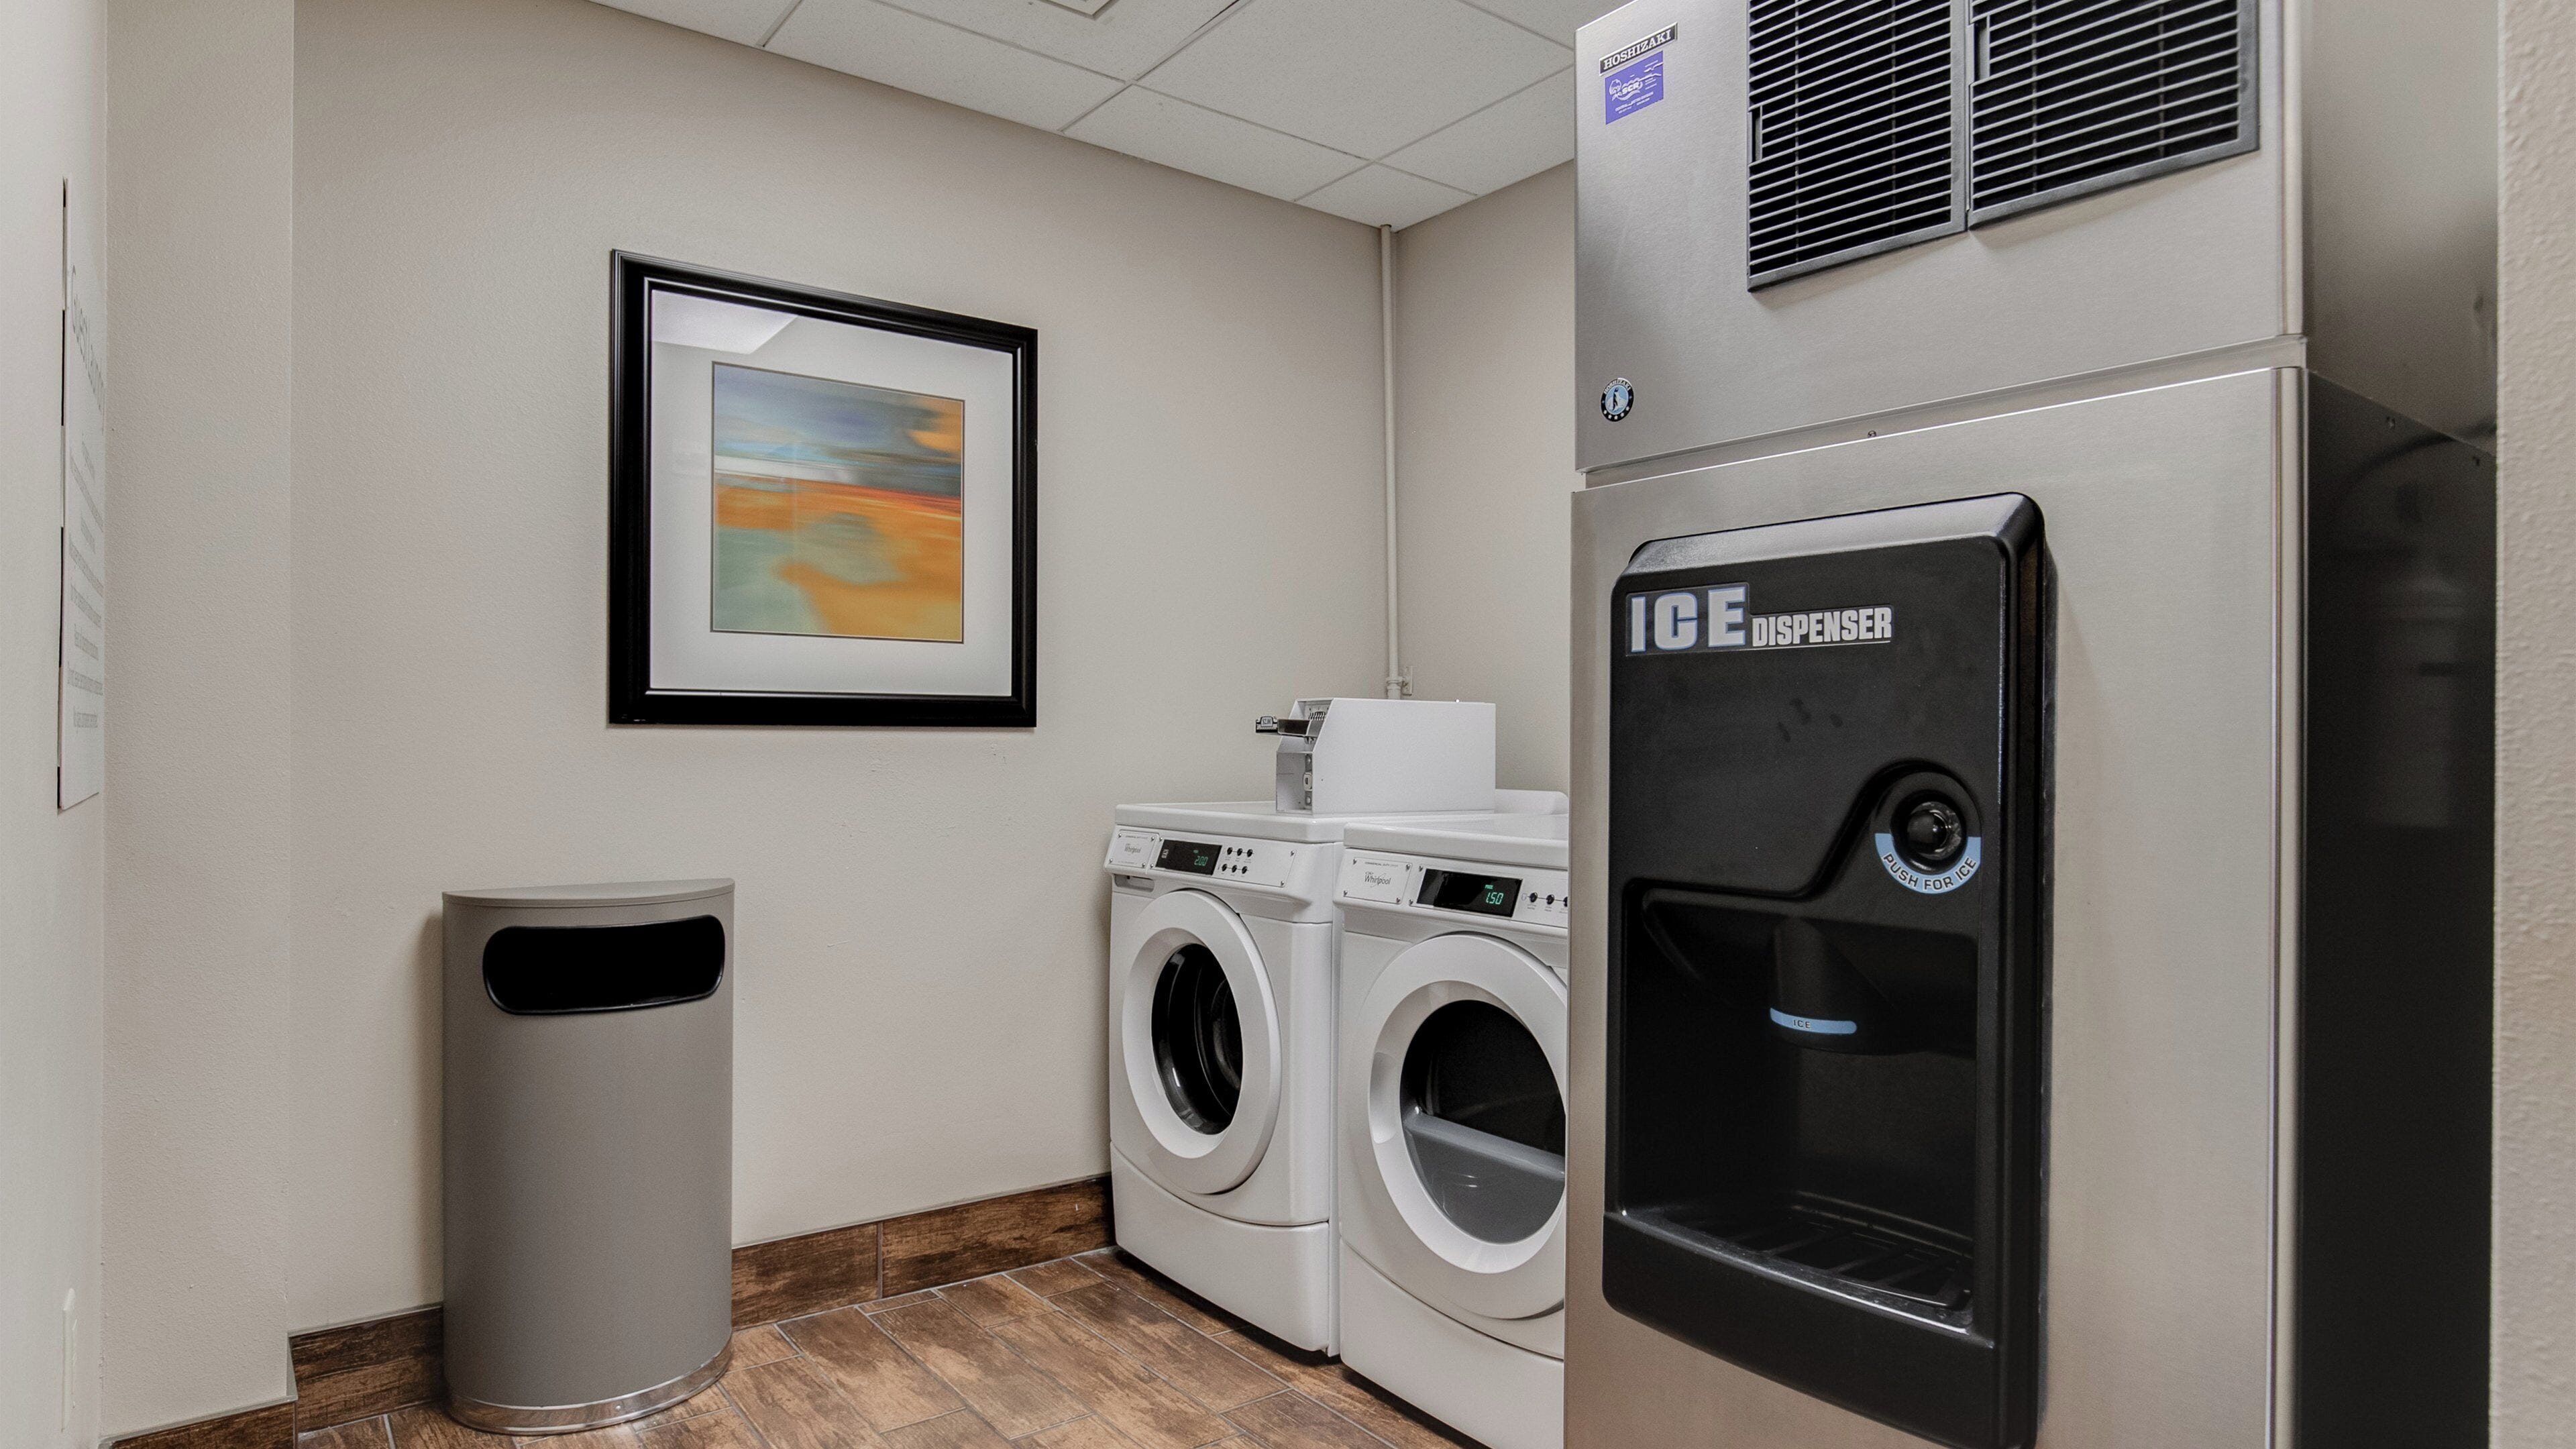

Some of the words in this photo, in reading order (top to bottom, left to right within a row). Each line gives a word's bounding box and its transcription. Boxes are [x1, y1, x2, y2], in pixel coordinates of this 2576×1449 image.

[1603, 29, 1672, 70] HOSHIZAKI
[1603, 379, 1631, 394] HOSHIZAKI
[1631, 586, 1746, 653] ICE
[1752, 606, 1892, 647] DISPENSER
[1364, 874, 1391, 885] Whirlpool
[1883, 853, 1919, 888] PUSH
[1923, 876, 1954, 891] FOR
[1955, 857, 1977, 881] ICE
[1793, 1019, 1811, 1029] ICE
